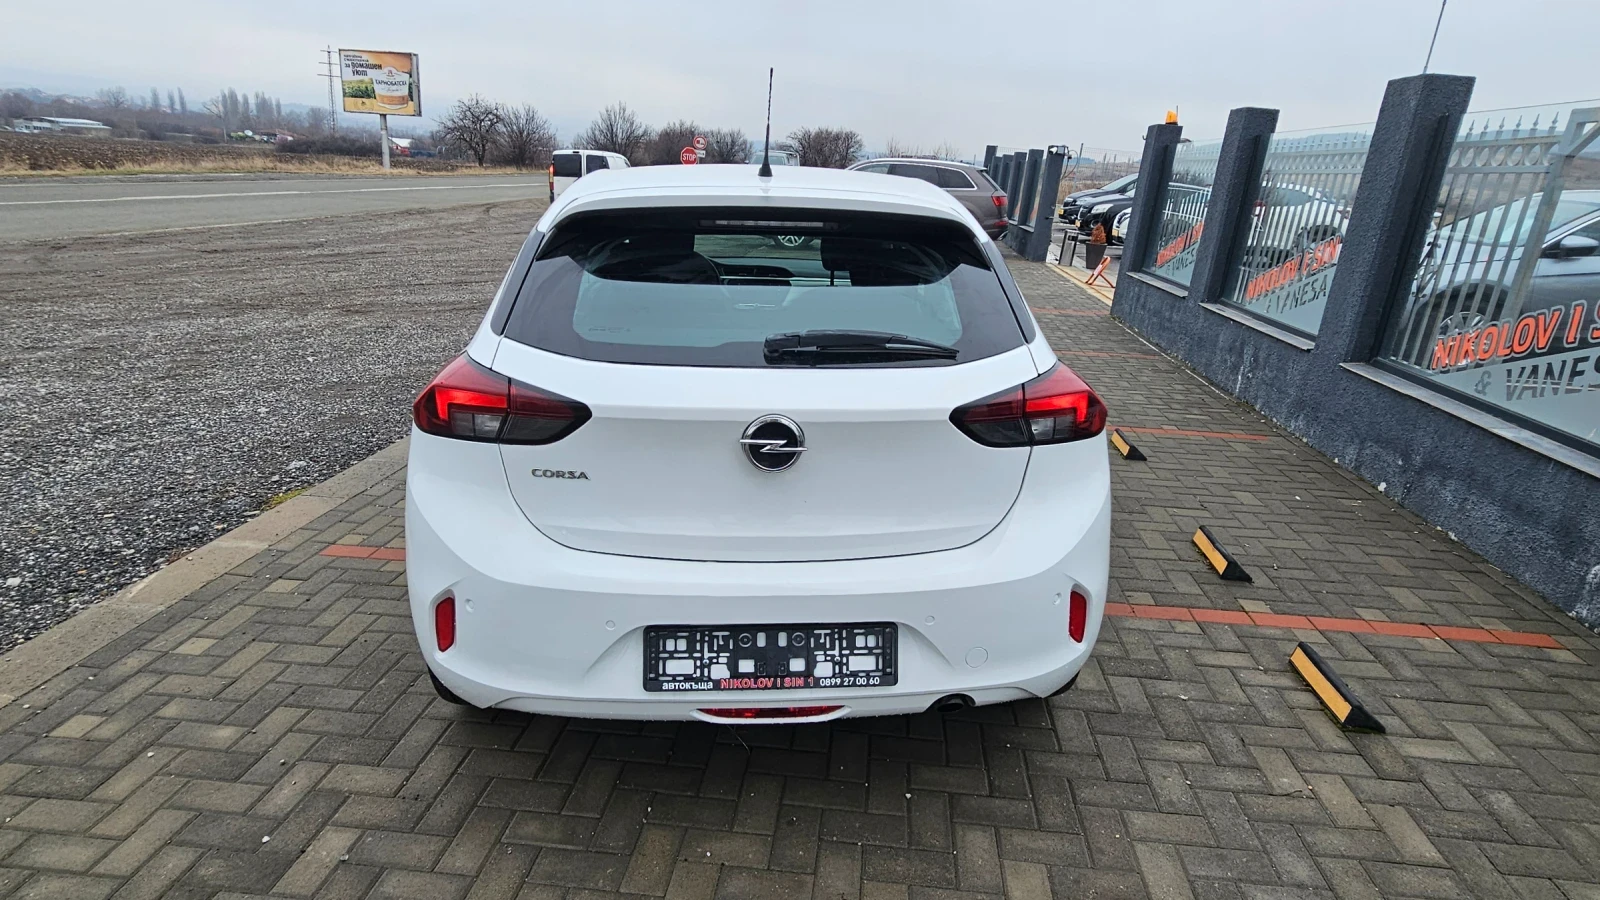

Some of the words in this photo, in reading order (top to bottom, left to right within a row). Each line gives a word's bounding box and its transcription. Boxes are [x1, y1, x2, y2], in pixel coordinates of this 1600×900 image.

[1246, 253, 1302, 302] NIKOLOV
[1276, 274, 1329, 314] VANESA
[1431, 307, 1563, 371] NIKOLOV
[1565, 302, 1586, 346] I
[1474, 370, 1492, 396] &
[531, 468, 590, 480] CORSA
[662, 681, 713, 690] автокъща
[720, 678, 773, 689] NIKOLOV
[784, 677, 804, 687] SIN
[807, 677, 814, 687] 1
[820, 678, 840, 686] 0899
[844, 678, 854, 686] 27
[869, 676, 880, 684] 60
